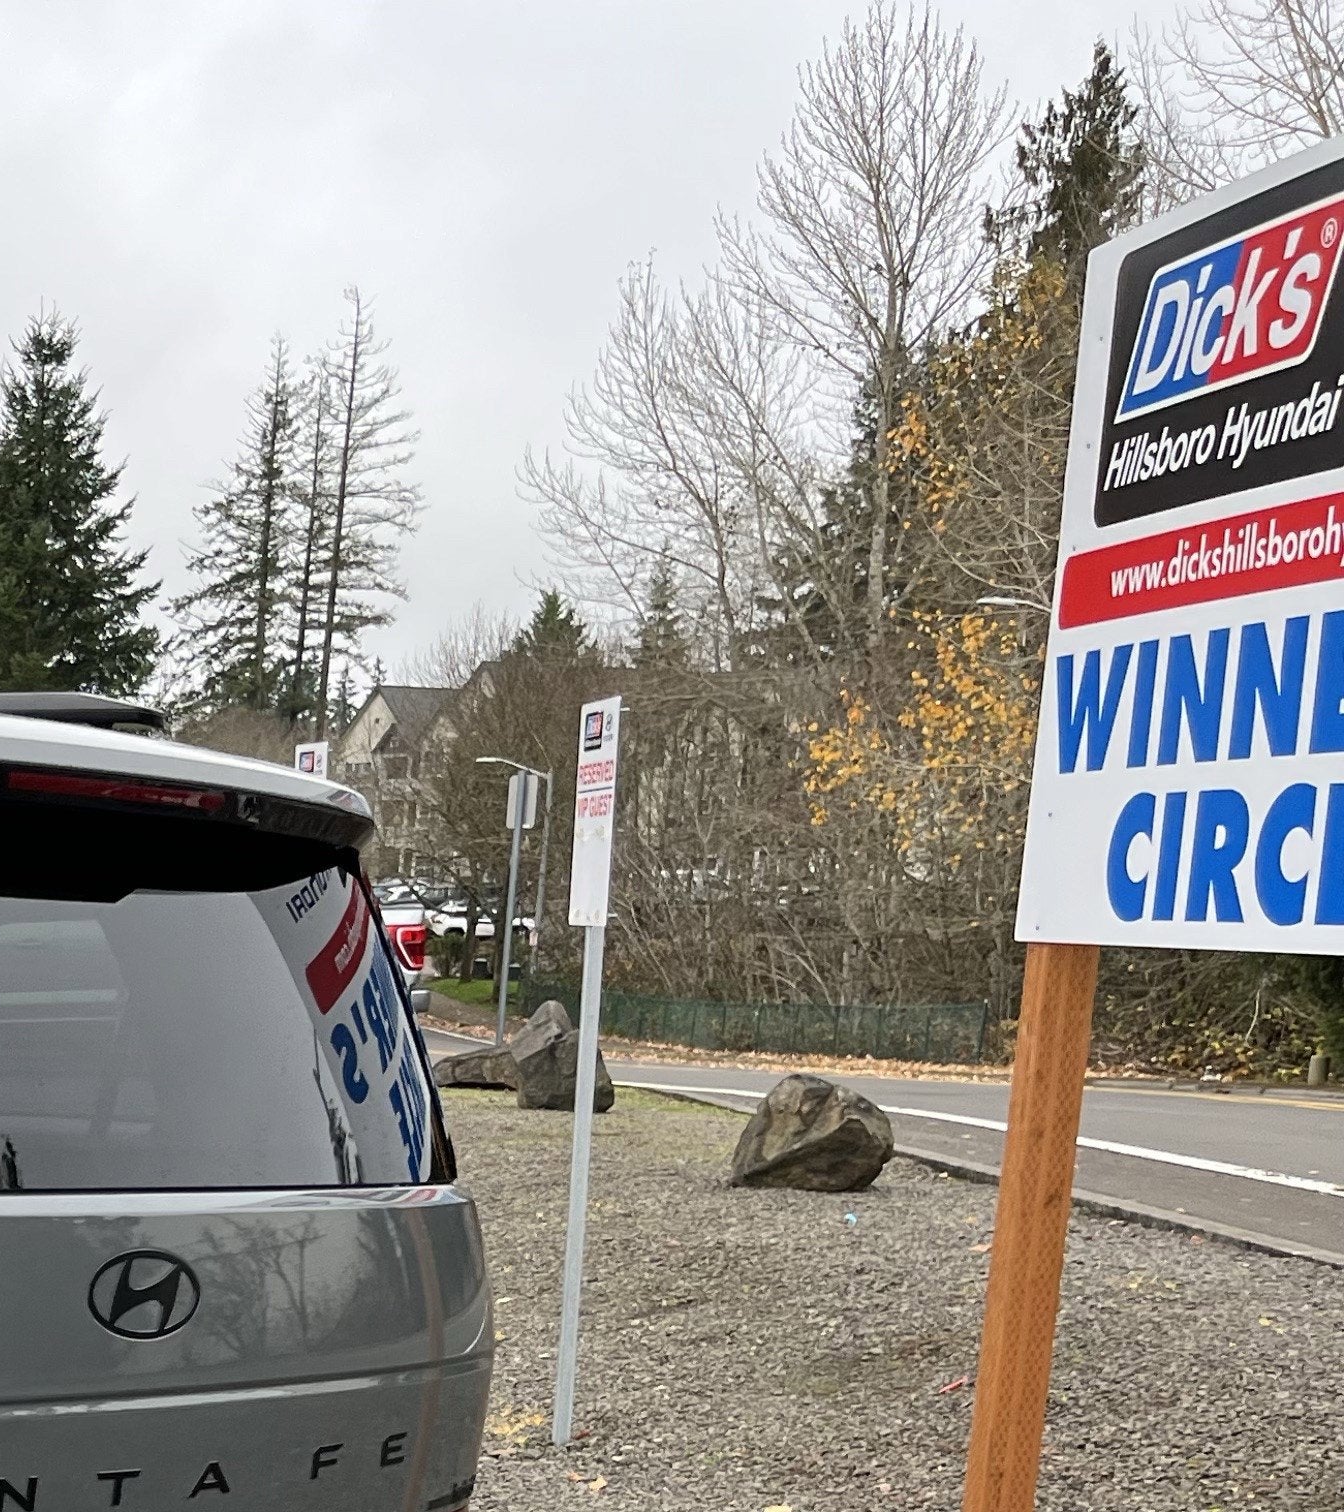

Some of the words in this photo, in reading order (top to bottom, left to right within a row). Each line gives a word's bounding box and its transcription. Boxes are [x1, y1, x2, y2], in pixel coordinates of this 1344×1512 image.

[1132, 227, 1321, 396] Dick's
[1103, 426, 1216, 491] Hillsboro
[1217, 374, 1344, 469] Hyundai
[1111, 505, 1344, 598] www.dickshillsboroh
[311, 1431, 410, 1480] FE
